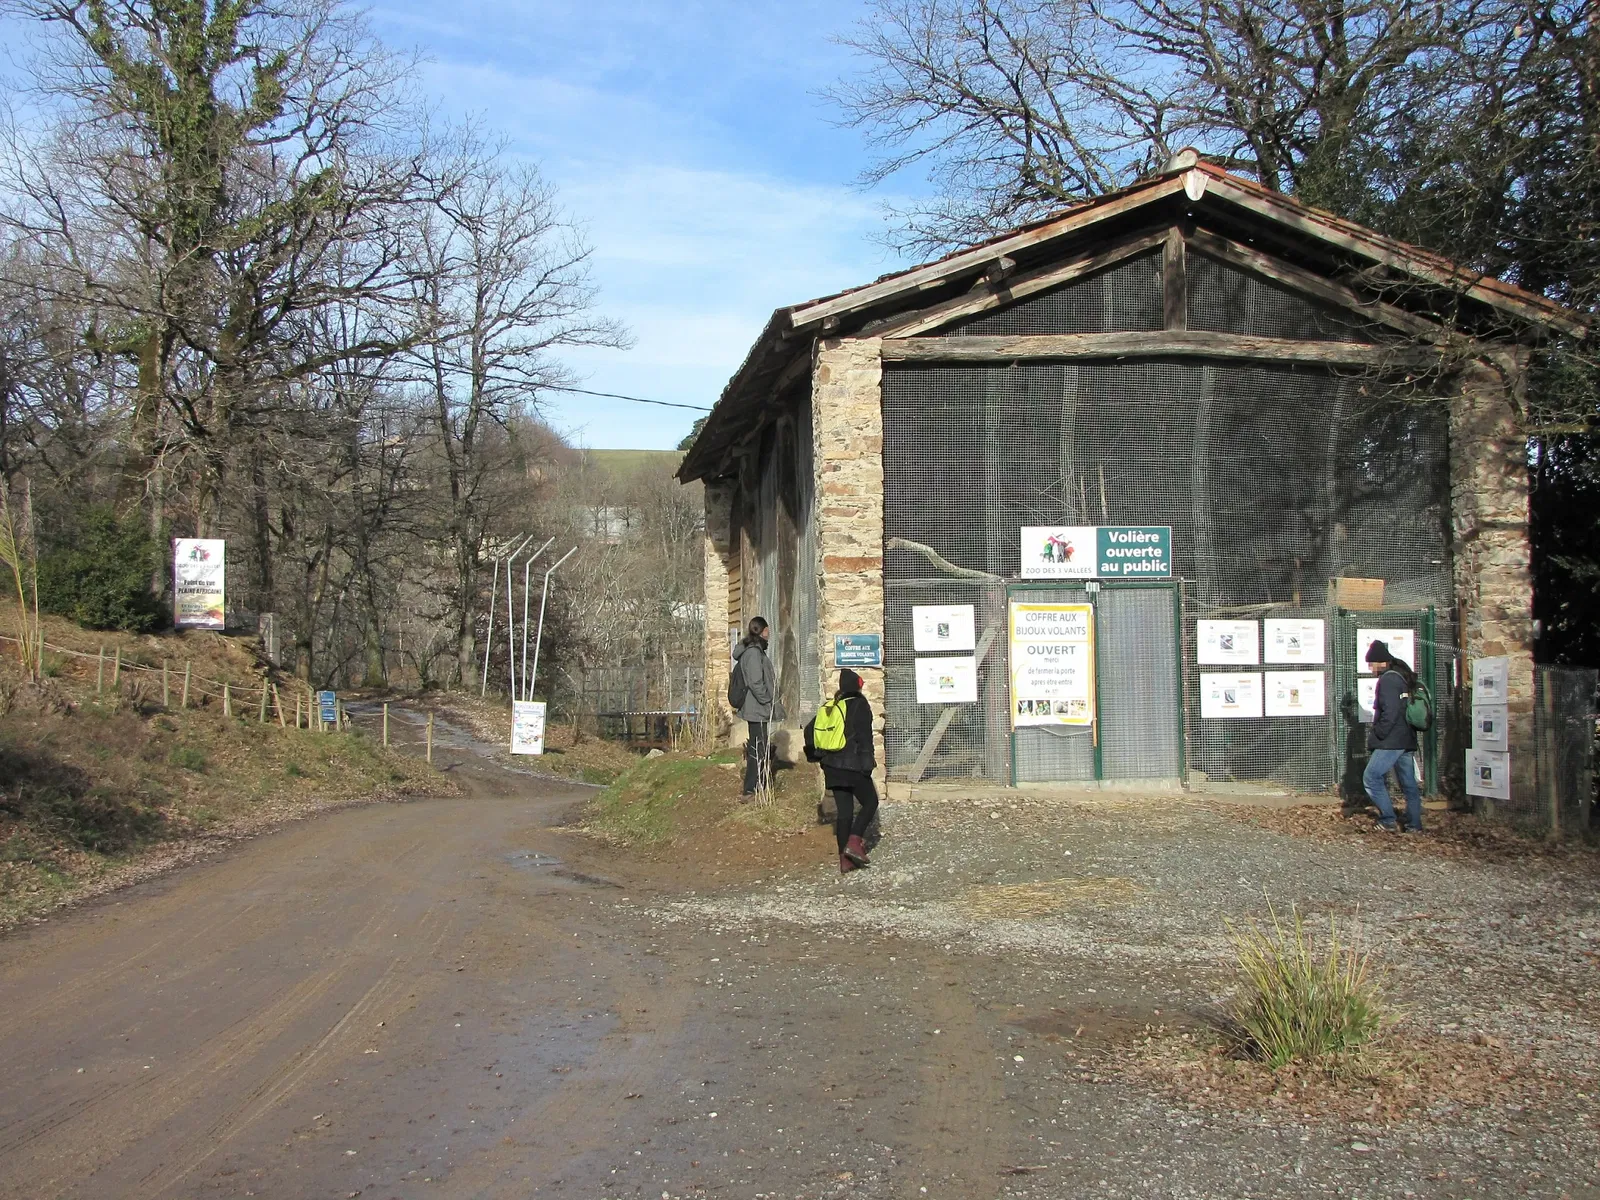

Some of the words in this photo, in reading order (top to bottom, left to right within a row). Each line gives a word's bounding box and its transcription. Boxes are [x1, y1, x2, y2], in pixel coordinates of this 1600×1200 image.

[1108, 531, 1160, 544] Volière
[1106, 546, 1163, 558] ouverte
[1101, 562, 1119, 573] au
[1123, 560, 1168, 574] public
[1025, 612, 1058, 622] COFFRE
[1057, 612, 1077, 622] AUX
[1016, 626, 1047, 636] BIJOUX
[1047, 626, 1087, 636] VOLANTS
[1026, 645, 1076, 655] OUVERT
[1027, 667, 1035, 675] de
[1035, 667, 1054, 675] fermer
[1054, 667, 1060, 675] la
[1060, 668, 1076, 676] porte
